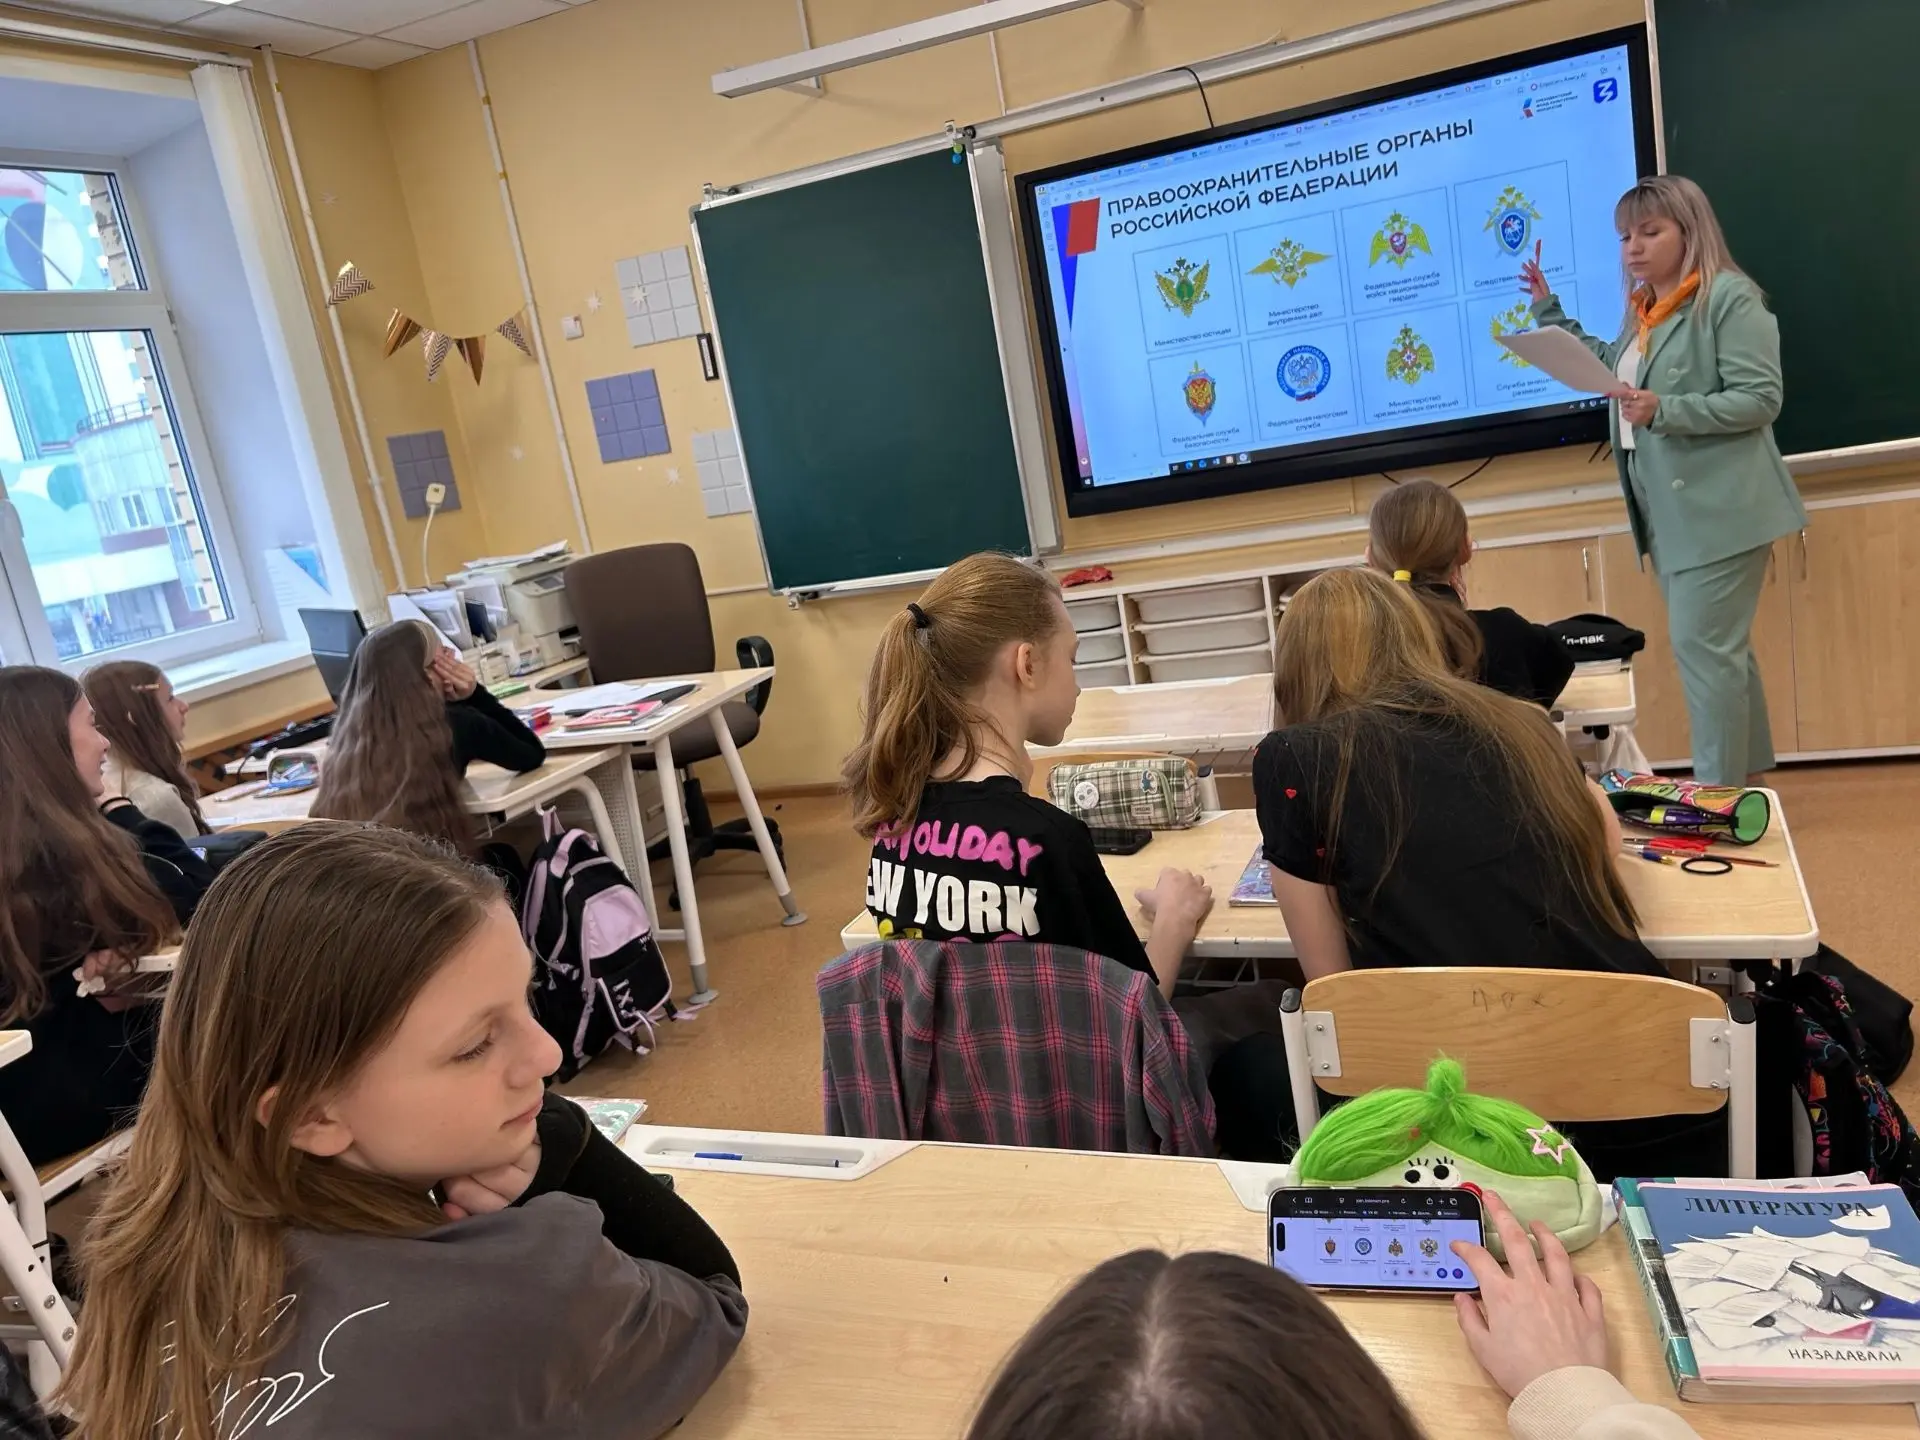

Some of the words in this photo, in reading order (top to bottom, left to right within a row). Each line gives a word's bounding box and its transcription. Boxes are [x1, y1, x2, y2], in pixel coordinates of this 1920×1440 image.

[1107, 142, 1370, 217] ПРАВООХРАНИТЕЛЬНЫЕ
[1377, 118, 1474, 156] ОРГАНЫ
[1110, 190, 1251, 239] РОССИЙСКОЙ
[1258, 161, 1399, 206] ФЕДЕРАЦИИ
[1363, 276, 1412, 292] Федеральная
[1412, 271, 1441, 285] служба
[1365, 287, 1387, 300] войск
[1388, 280, 1440, 297] национальной
[1267, 313, 1308, 327] внутренних
[1309, 311, 1323, 321] дел
[1268, 303, 1319, 318] Министерство
[1154, 333, 1202, 347] Министерство
[1202, 328, 1232, 339] юстиции
[1496, 381, 1526, 393] Служба
[1388, 394, 1442, 408] Министерство
[1267, 416, 1312, 428] Федеральная
[1313, 410, 1348, 421] налоговая
[1295, 422, 1321, 433] служба
[1172, 431, 1216, 444] Федеральная
[1216, 427, 1240, 438] служба
[866, 857, 906, 918] EW
[913, 867, 1041, 937] YORK
[1684, 1197, 1876, 1218] ЛИТЕРАТУРА
[1787, 1348, 1903, 1363] НАЗАДАВАЛИ
